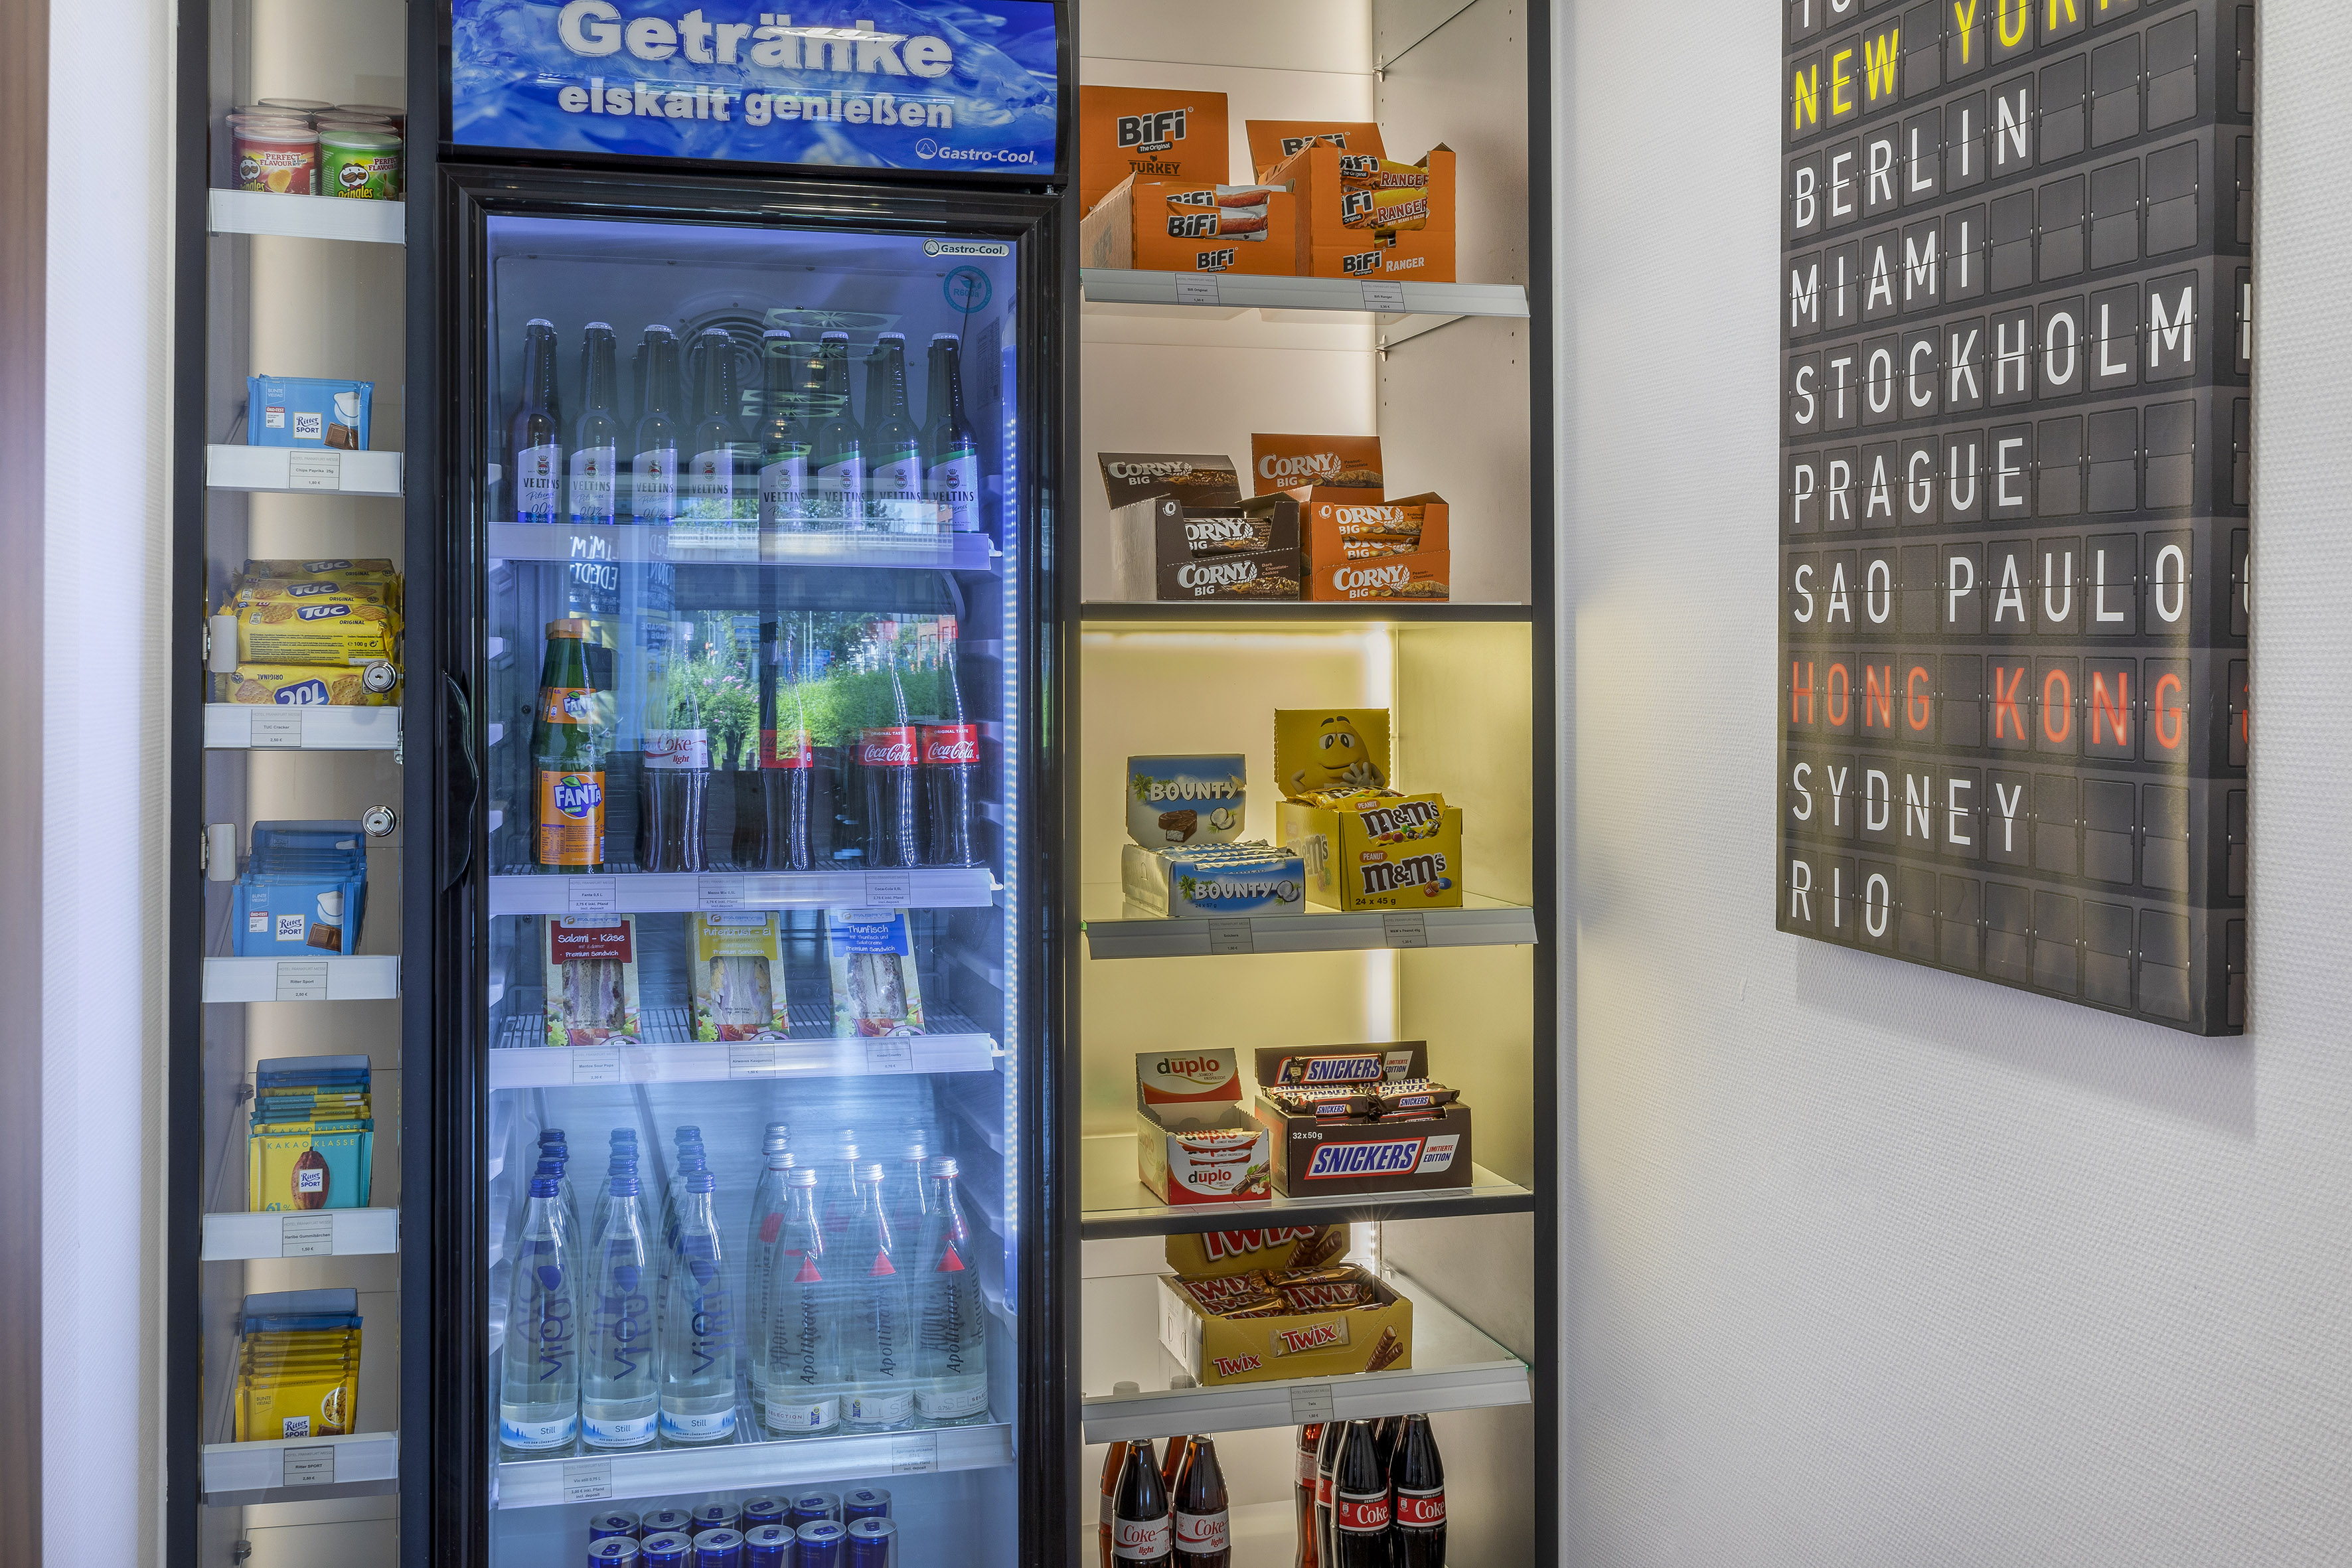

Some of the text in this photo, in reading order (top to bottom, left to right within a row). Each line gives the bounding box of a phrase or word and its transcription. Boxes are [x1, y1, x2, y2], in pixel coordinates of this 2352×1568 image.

[557, 1, 953, 78] Getränke
[1796, 0, 2109, 129] NEW YO
[558, 78, 953, 128] eiskalt genießen
[1117, 108, 1186, 148] BiFi
[1150, 143, 1170, 151] Original
[939, 146, 1035, 164] Gastro-Cool
[1796, 89, 2027, 228] BERLIN
[1129, 161, 1181, 175] TURKEY
[1167, 213, 1217, 237] BiFi
[940, 243, 1004, 256] Gastro-Cool
[1197, 248, 1234, 270] BiFi
[1343, 250, 1425, 274] BiFi RANGER
[1792, 222, 1968, 327] MIAMI
[1795, 286, 2193, 425] STOCKHOLM
[296, 417, 319, 427] Ritter
[1258, 452, 1334, 479] CORNY
[523, 478, 560, 490] VELTINS
[573, 481, 611, 491] VELTINS
[1129, 477, 1150, 485] BIG
[1277, 477, 1298, 487] BIG
[1795, 437, 2023, 524] PRAGUE
[637, 483, 674, 493] VELTINS
[692, 484, 728, 495] VELTINS
[763, 491, 805, 503] VELTINS
[933, 491, 974, 502] VELTINS
[1339, 525, 1360, 535] BIG
[1348, 549, 1370, 559] BIG
[308, 560, 349, 570] TUC
[1178, 561, 1251, 588] CORNY
[1333, 564, 1403, 591] CORNY
[292, 584, 335, 594] TUC
[1794, 544, 2184, 623] SAO PAULO
[1195, 586, 1214, 596] BIG
[1349, 588, 1368, 599] BIG
[301, 605, 347, 617] TUC
[1792, 661, 2183, 749] HONG KONG
[658, 733, 691, 751] Coke
[864, 744, 912, 762] Coca-Cola
[928, 741, 975, 760] Coca-Cola
[673, 755, 689, 764] light
[554, 785, 603, 807] FANTA
[1150, 782, 1239, 802] BOUNTY
[1792, 763, 2021, 852] SYDNEY
[1195, 882, 1274, 900] BOUNTY
[1792, 860, 1889, 937] RIO
[279, 919, 301, 929] Ritter
[847, 925, 888, 933] Thunfisch
[558, 934, 589, 943] Salami
[1156, 1056, 1219, 1077] duplo
[1308, 1058, 1383, 1079] SNICKERS
[1399, 1097, 1429, 1107] SNICKERS
[1317, 1105, 1346, 1115] SNICKERS
[314, 1138, 355, 1147] KLASSE
[1312, 1143, 1418, 1174] SNICKERS
[1423, 1153, 1452, 1162] EDITION
[301, 1172, 321, 1182] Ritter
[1188, 1169, 1231, 1184] duplo
[266, 1203, 281, 1212] 61
[285, 1421, 307, 1431] Ritter
[540, 1427, 556, 1435] Still
[615, 1425, 631, 1433] Still
[1357, 1505, 1389, 1524] Coke
[1415, 1500, 1445, 1520] Coke
[1123, 1525, 1156, 1542] Coke
[1195, 1519, 1225, 1536] Coke
[1211, 1537, 1223, 1547] light
[1138, 1546, 1154, 1556] light
